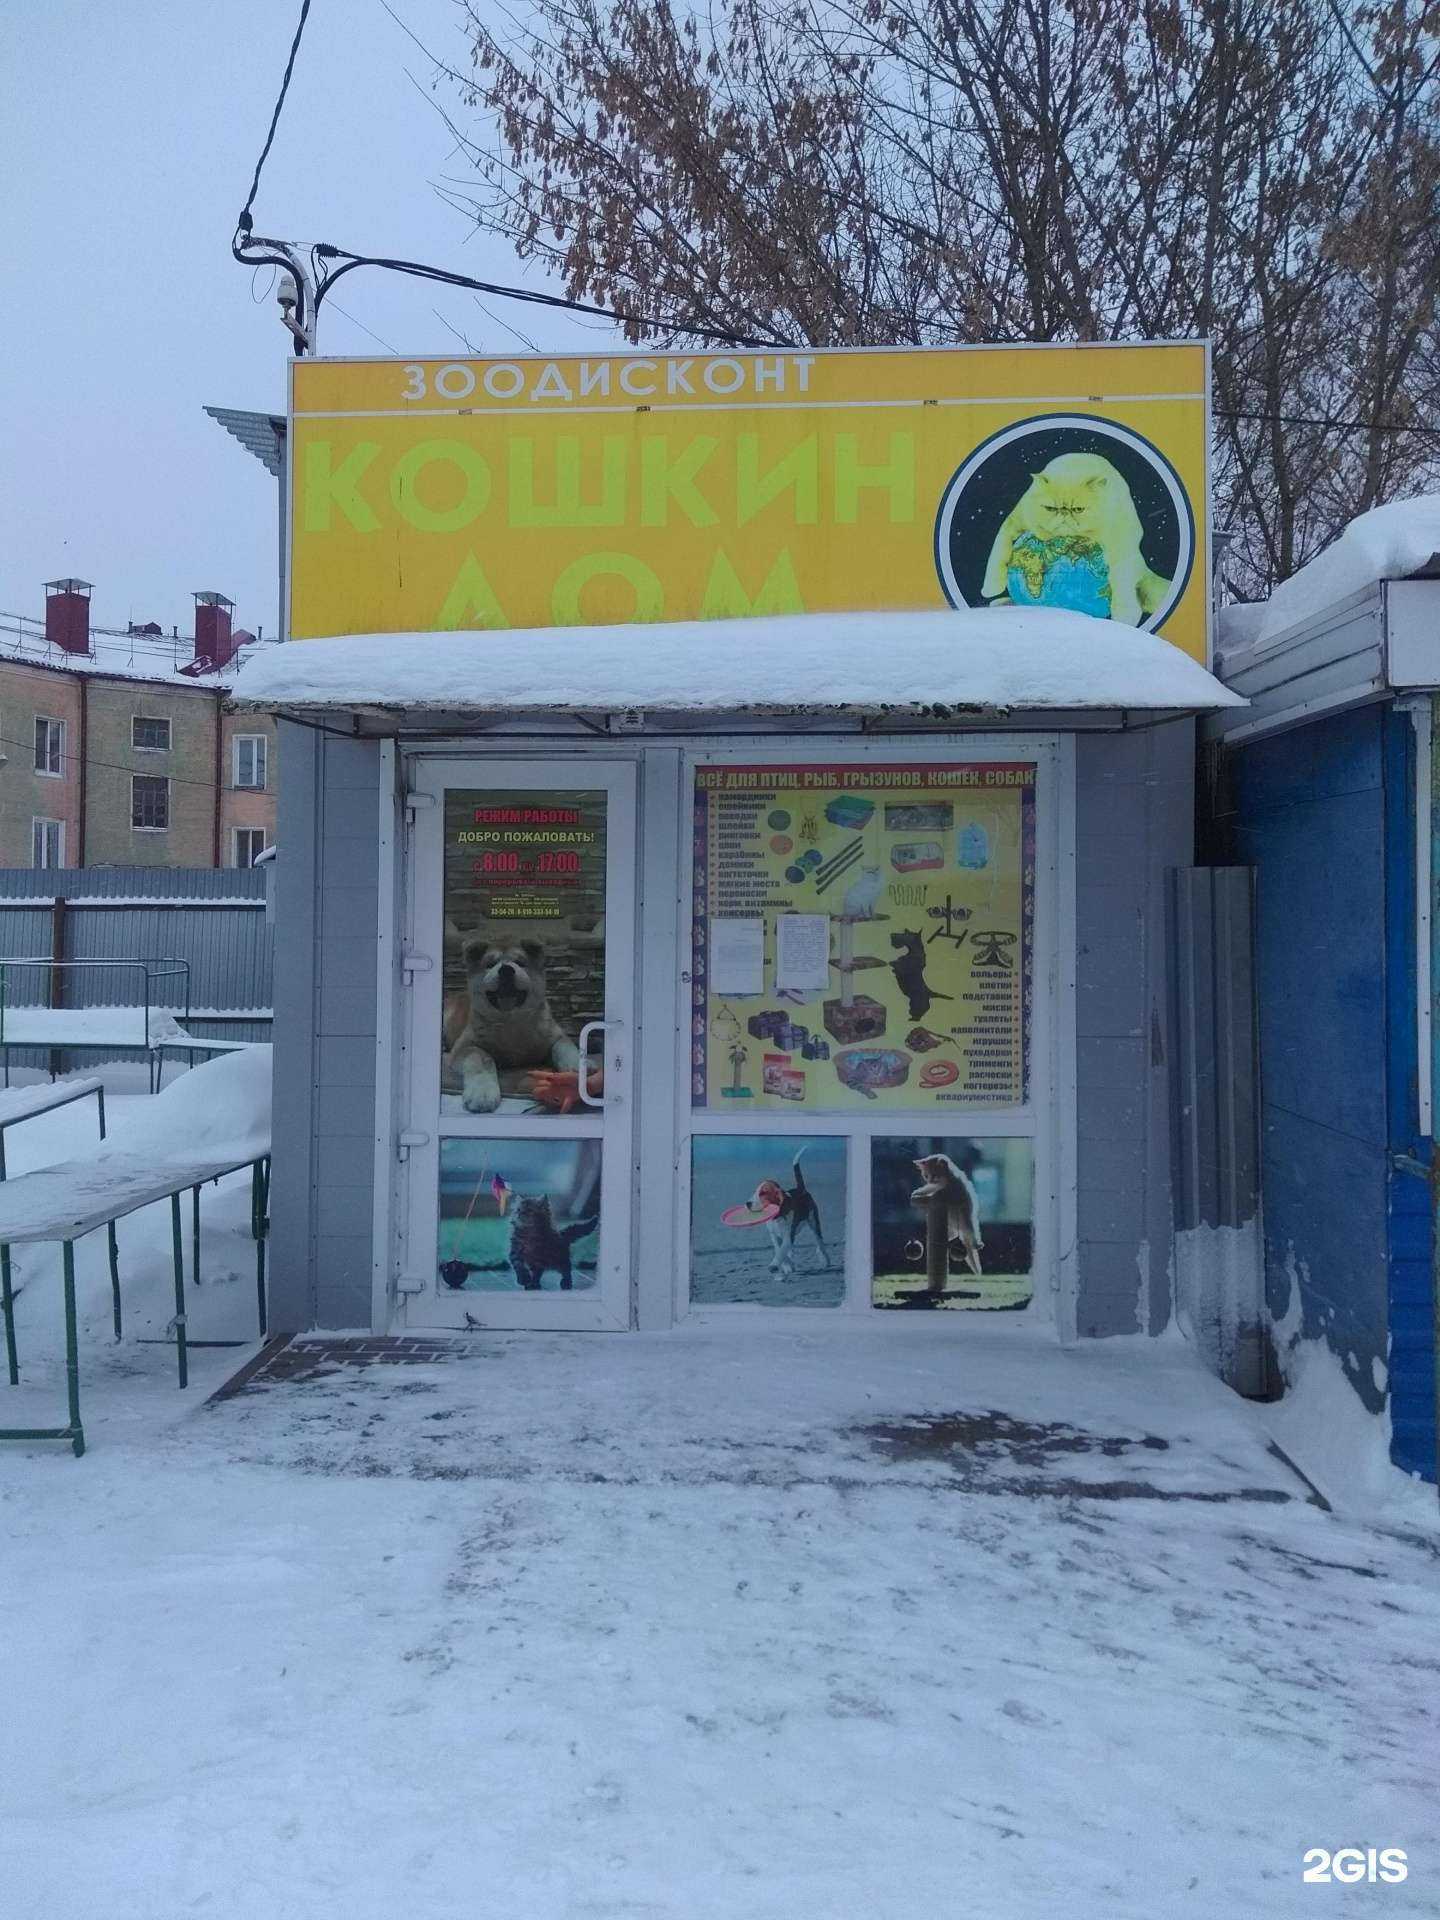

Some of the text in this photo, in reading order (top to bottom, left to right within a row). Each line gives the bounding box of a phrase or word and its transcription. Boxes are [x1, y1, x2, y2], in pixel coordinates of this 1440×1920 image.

[401, 357, 816, 401] ЗООДИСКОНТ
[304, 432, 915, 533] КОШКИН
[726, 773, 759, 788] ДЛЯ
[804, 772, 841, 787] РЫБ,
[474, 808, 520, 824] РЕЖИМ
[458, 831, 594, 843] ДОБРО ПОЖАЛОВАТЬ!
